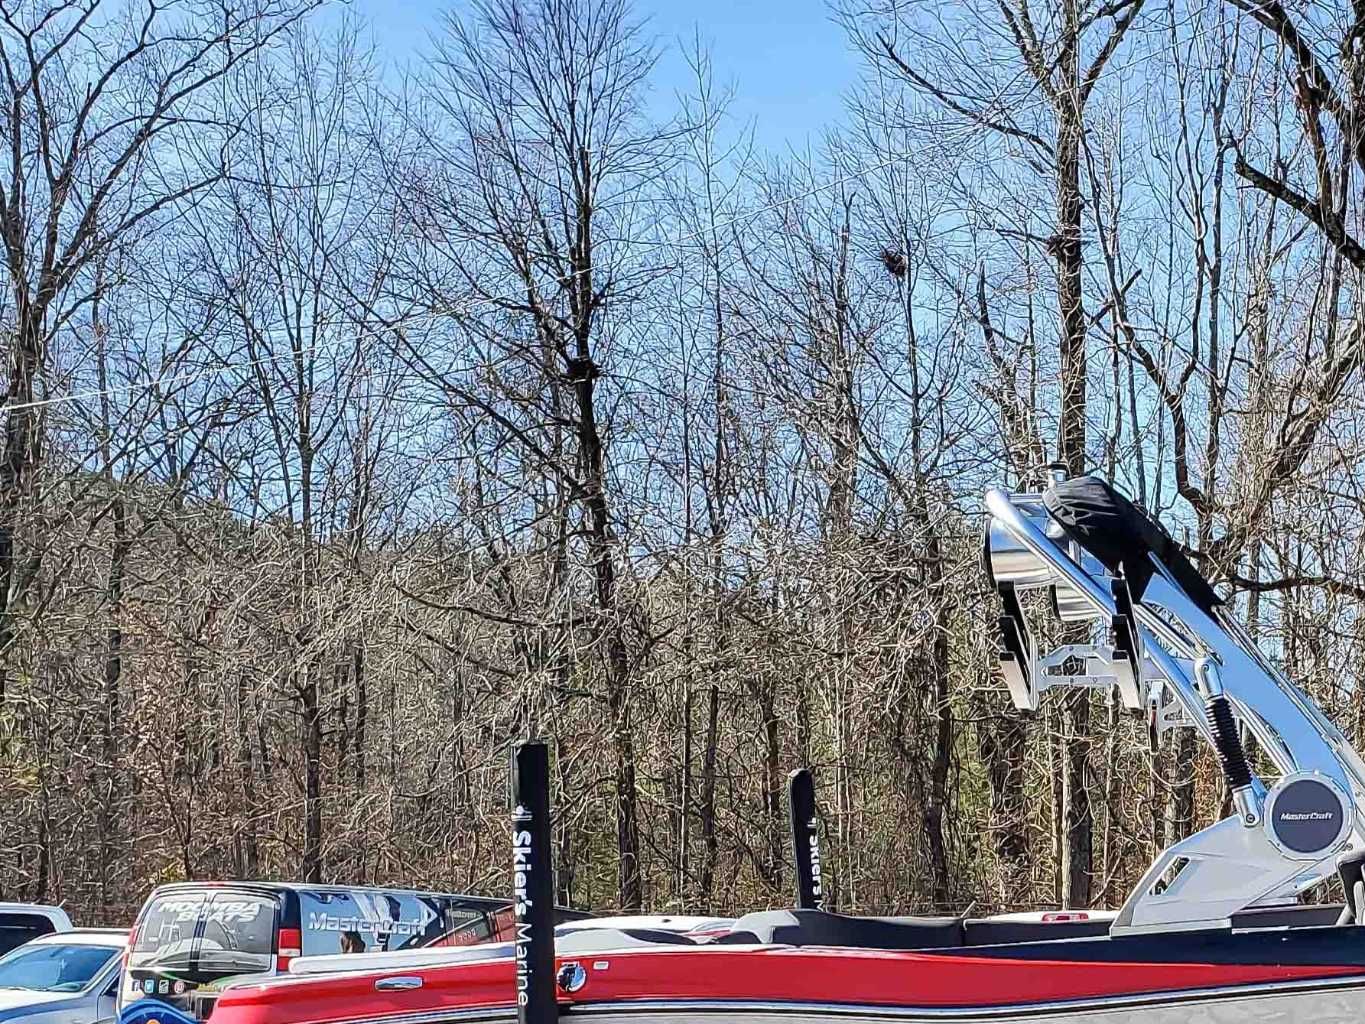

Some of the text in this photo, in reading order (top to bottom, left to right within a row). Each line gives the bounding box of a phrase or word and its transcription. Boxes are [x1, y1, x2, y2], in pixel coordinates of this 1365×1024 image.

[1281, 812, 1333, 821] MasterCraft
[307, 911, 427, 936] MasterCraft
[512, 830, 533, 1006] Skier's Marine
